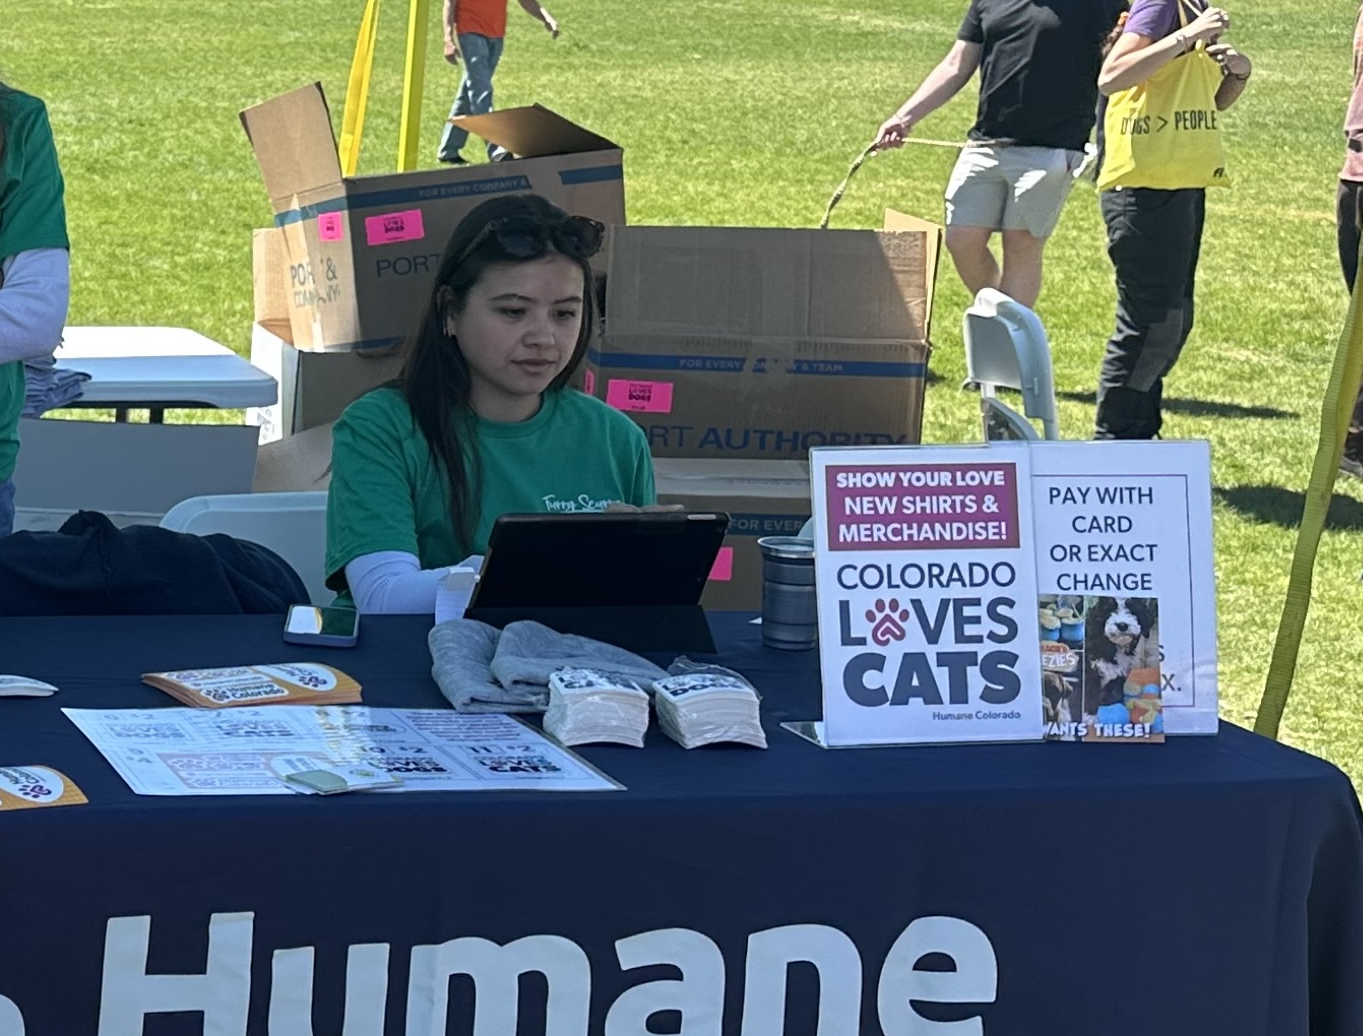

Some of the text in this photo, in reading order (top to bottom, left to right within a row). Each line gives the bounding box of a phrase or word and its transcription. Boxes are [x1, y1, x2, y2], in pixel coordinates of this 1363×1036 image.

[1174, 109, 1217, 131] PEOPLE
[326, 256, 338, 282] &
[679, 359, 704, 369] FOR
[705, 360, 741, 371] EVERY
[811, 364, 843, 373] TEAM
[697, 427, 908, 451] AUTHORITY
[836, 470, 1005, 489] SHOW YOUR LOVE
[844, 495, 1000, 516] NEW SHIRTS &
[1048, 486, 1154, 506] PAY WITH
[763, 519, 804, 531] EVER
[838, 521, 1007, 544] MERCHANDISE!
[1072, 515, 1133, 535] CARD
[1049, 543, 1158, 563] OR EXACT
[836, 561, 1016, 591] COLORADO
[1056, 571, 1153, 592] CHANGE
[842, 650, 1022, 708] CATS
[932, 710, 1021, 722] Humane Colorado
[1093, 722, 1153, 738] THESE!
